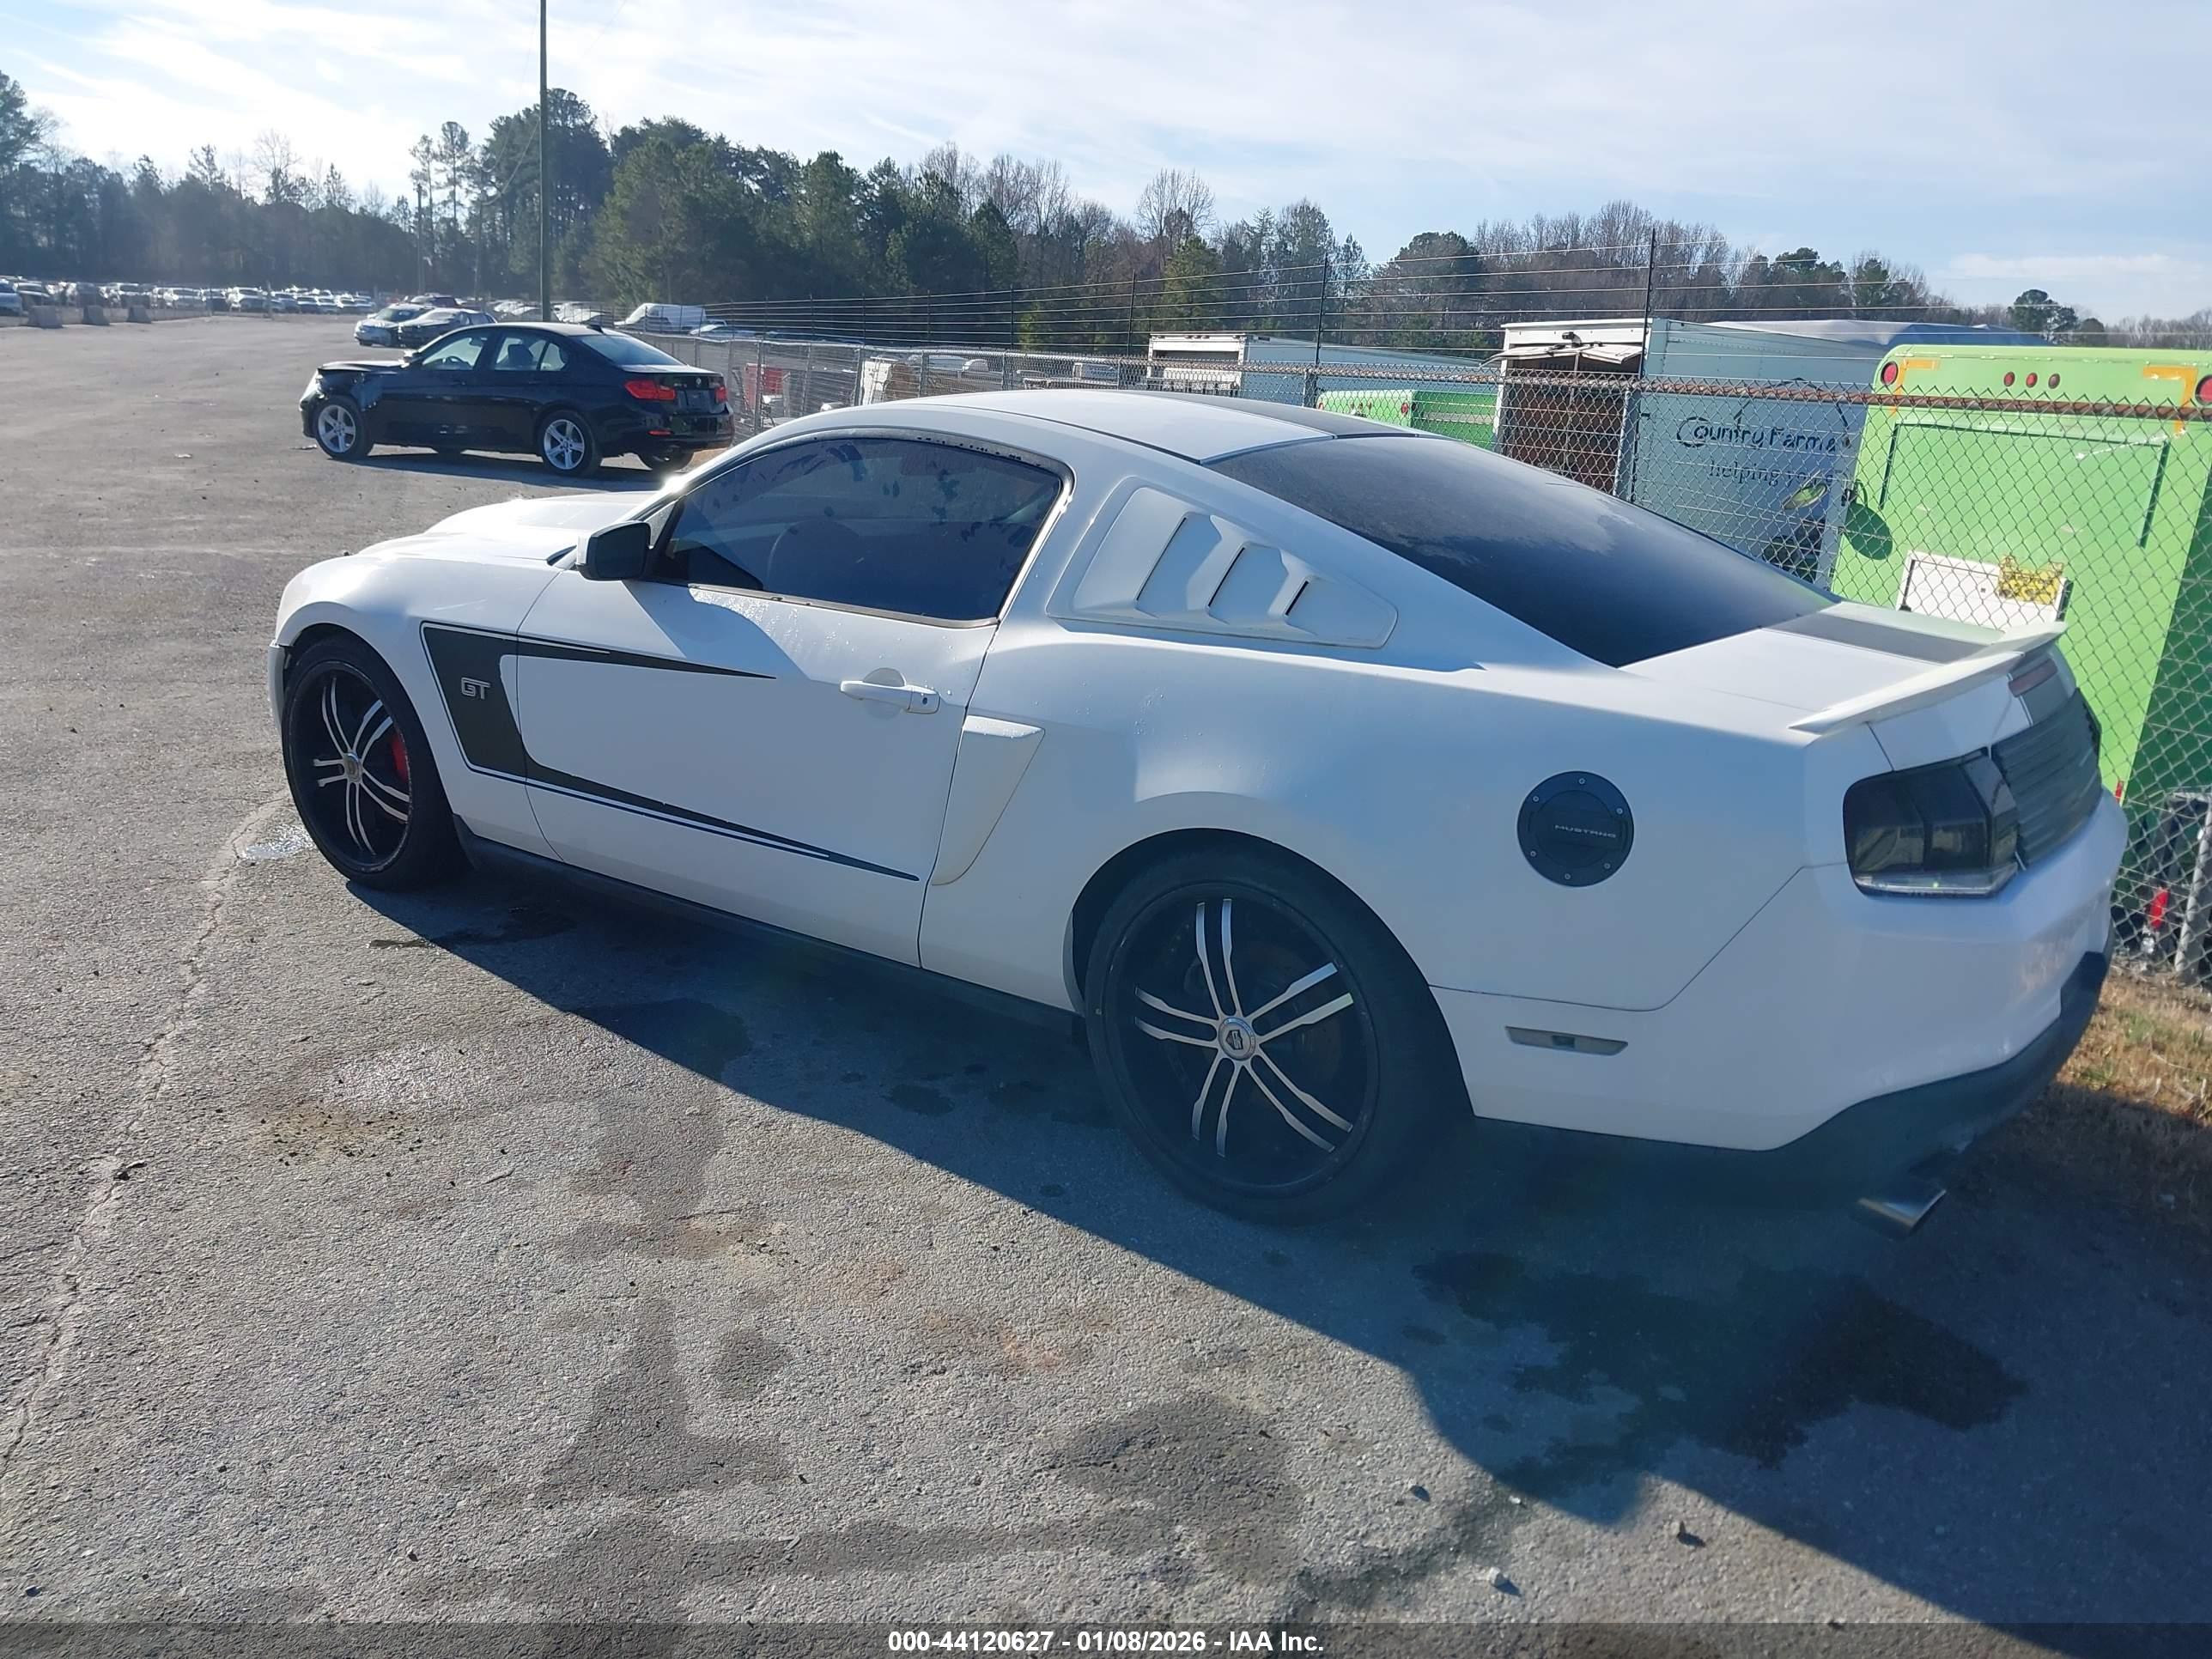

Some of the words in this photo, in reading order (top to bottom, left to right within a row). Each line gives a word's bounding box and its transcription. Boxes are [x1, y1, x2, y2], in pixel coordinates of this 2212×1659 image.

[1676, 416, 1764, 450] Country
[1769, 426, 1822, 451] Farm
[1710, 458, 1782, 487] helping
[461, 677, 491, 700] GT
[1554, 824, 1617, 839] MUSTANG
